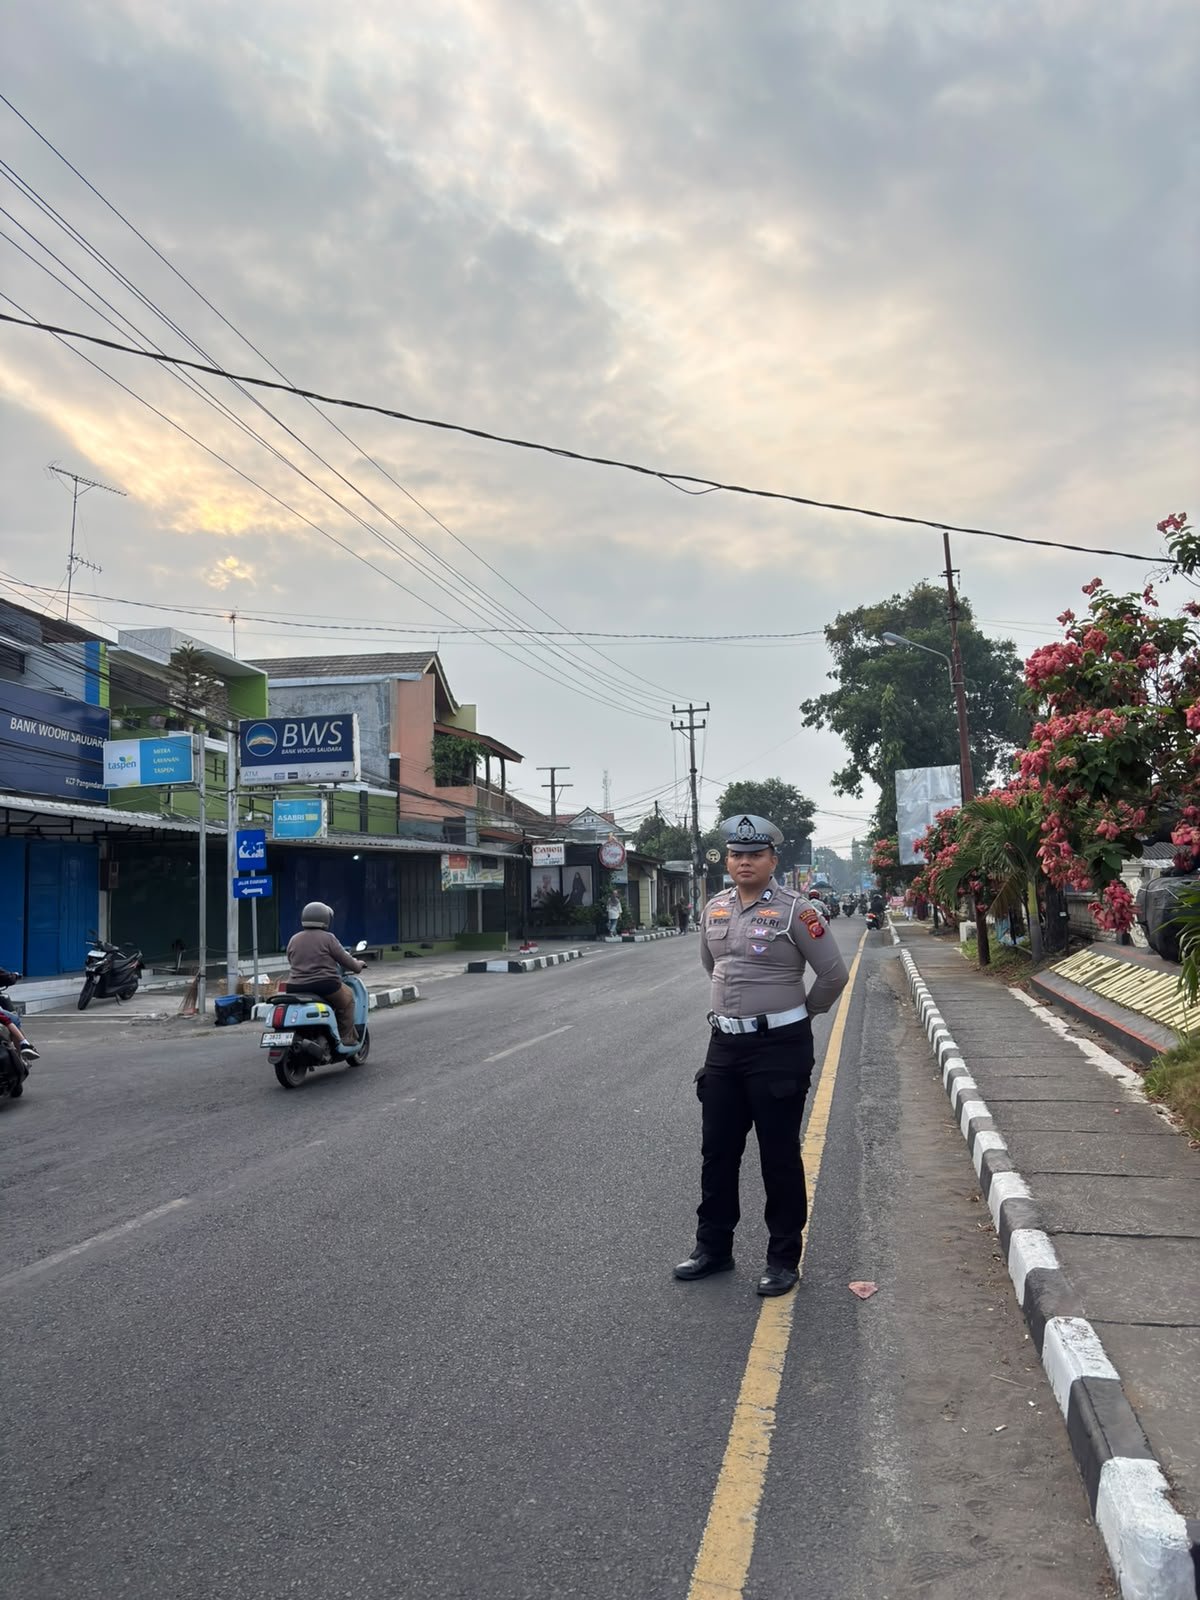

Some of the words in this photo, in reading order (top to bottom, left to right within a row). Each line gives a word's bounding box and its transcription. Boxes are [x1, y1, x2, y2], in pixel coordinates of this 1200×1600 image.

[10, 717, 37, 735] BANK
[38, 723, 70, 741] WOORI
[282, 720, 343, 748] BWS
[108, 760, 137, 771] taspen
[278, 814, 305, 822] ASABRI
[533, 845, 562, 854] Canon
[750, 917, 780, 928] POLRI
